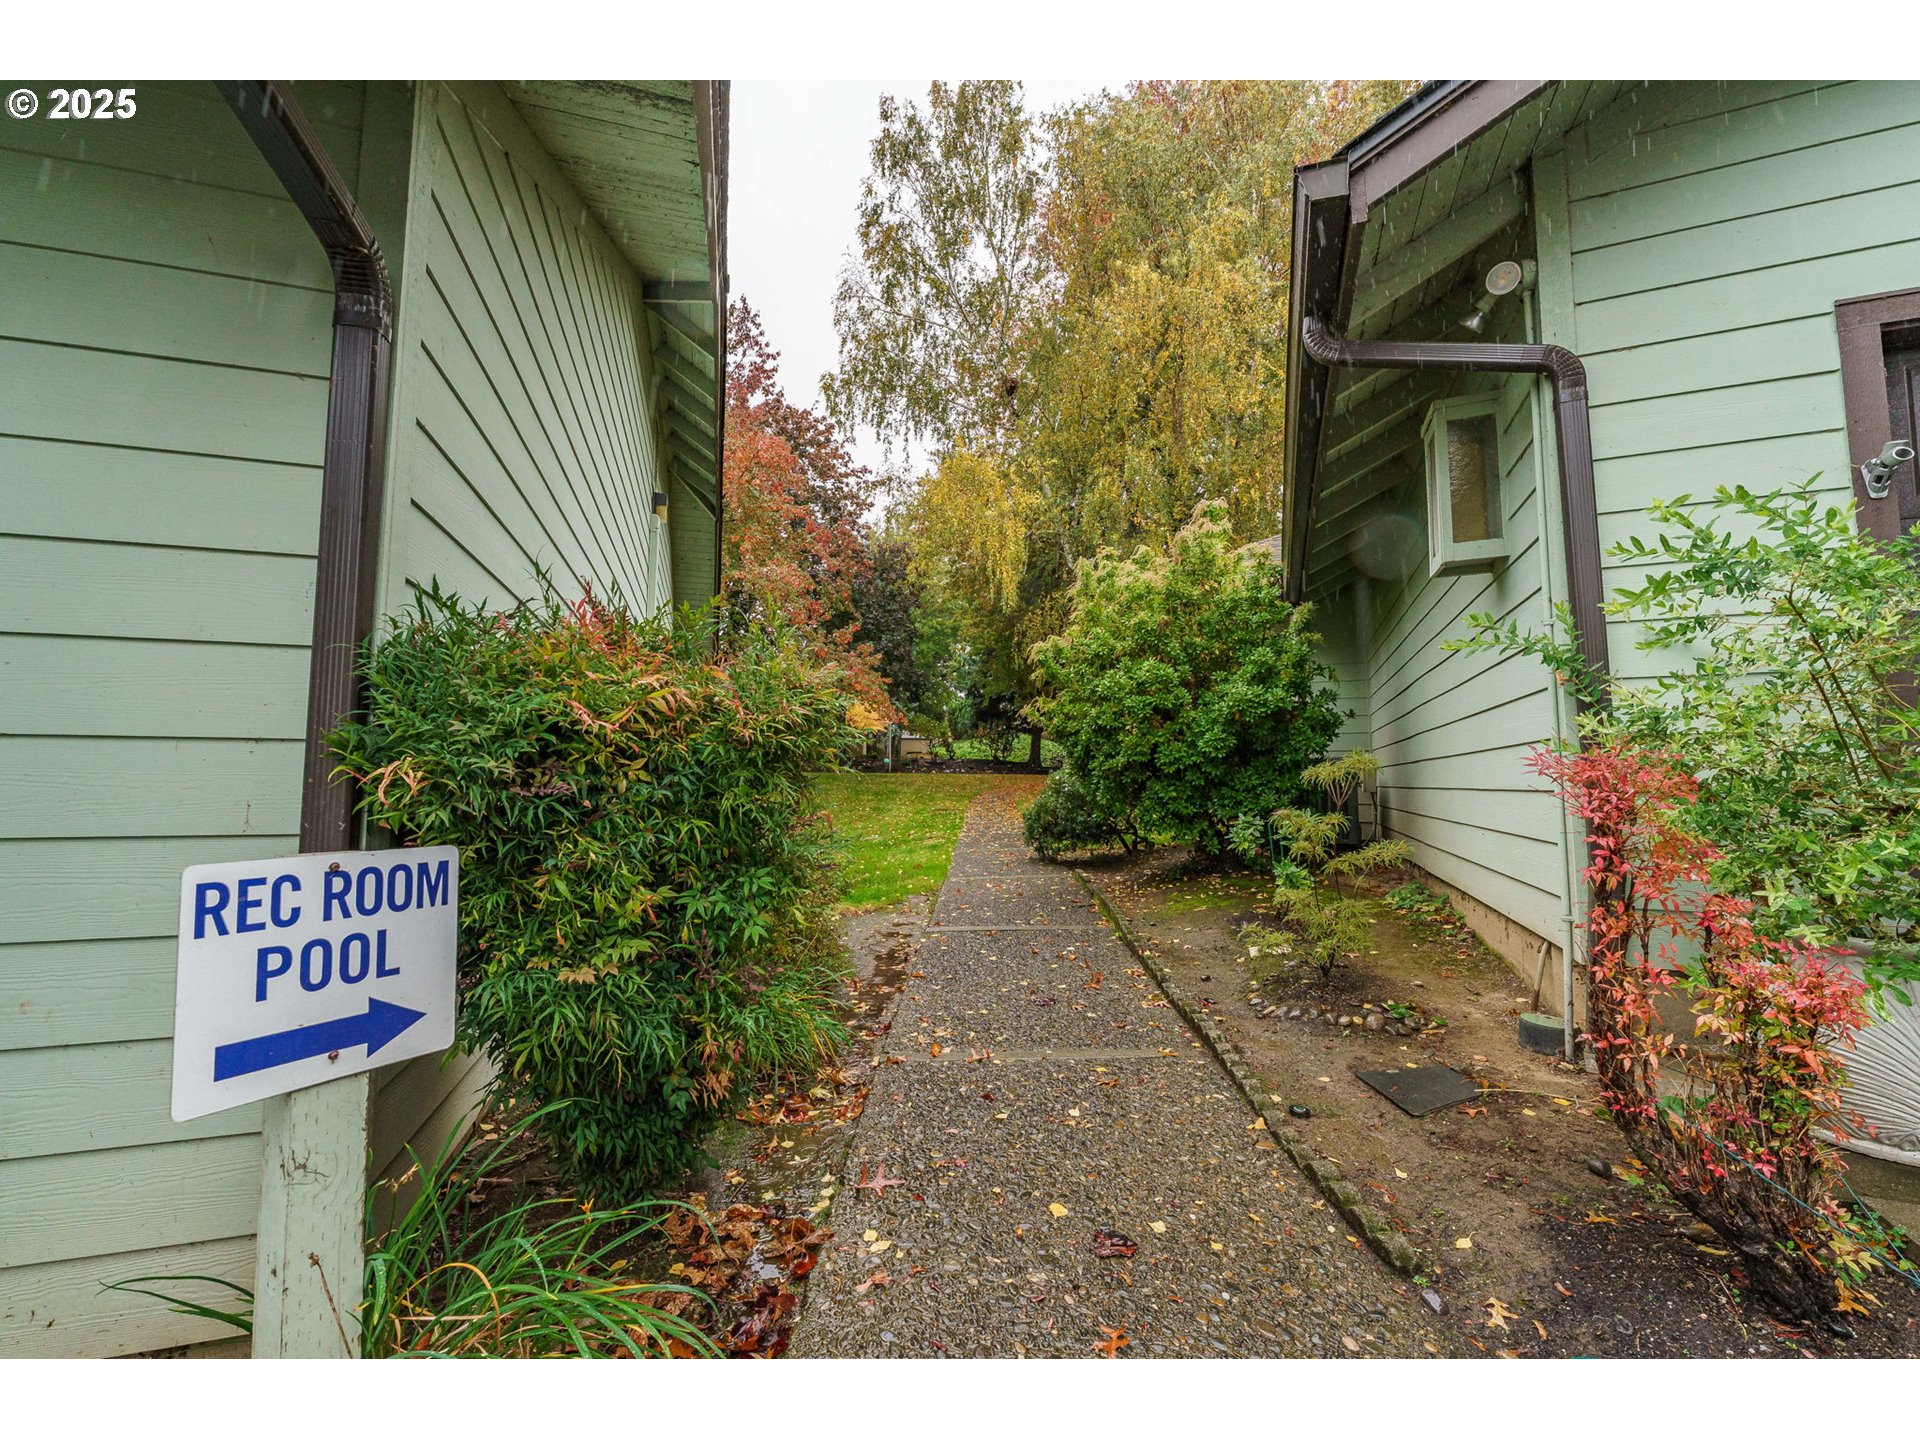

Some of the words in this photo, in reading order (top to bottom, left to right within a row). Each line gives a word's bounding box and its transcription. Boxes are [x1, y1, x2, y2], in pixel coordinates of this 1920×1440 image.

[193, 874, 302, 940] REC
[322, 860, 450, 922] ROOM
[255, 929, 401, 1003] POOL
